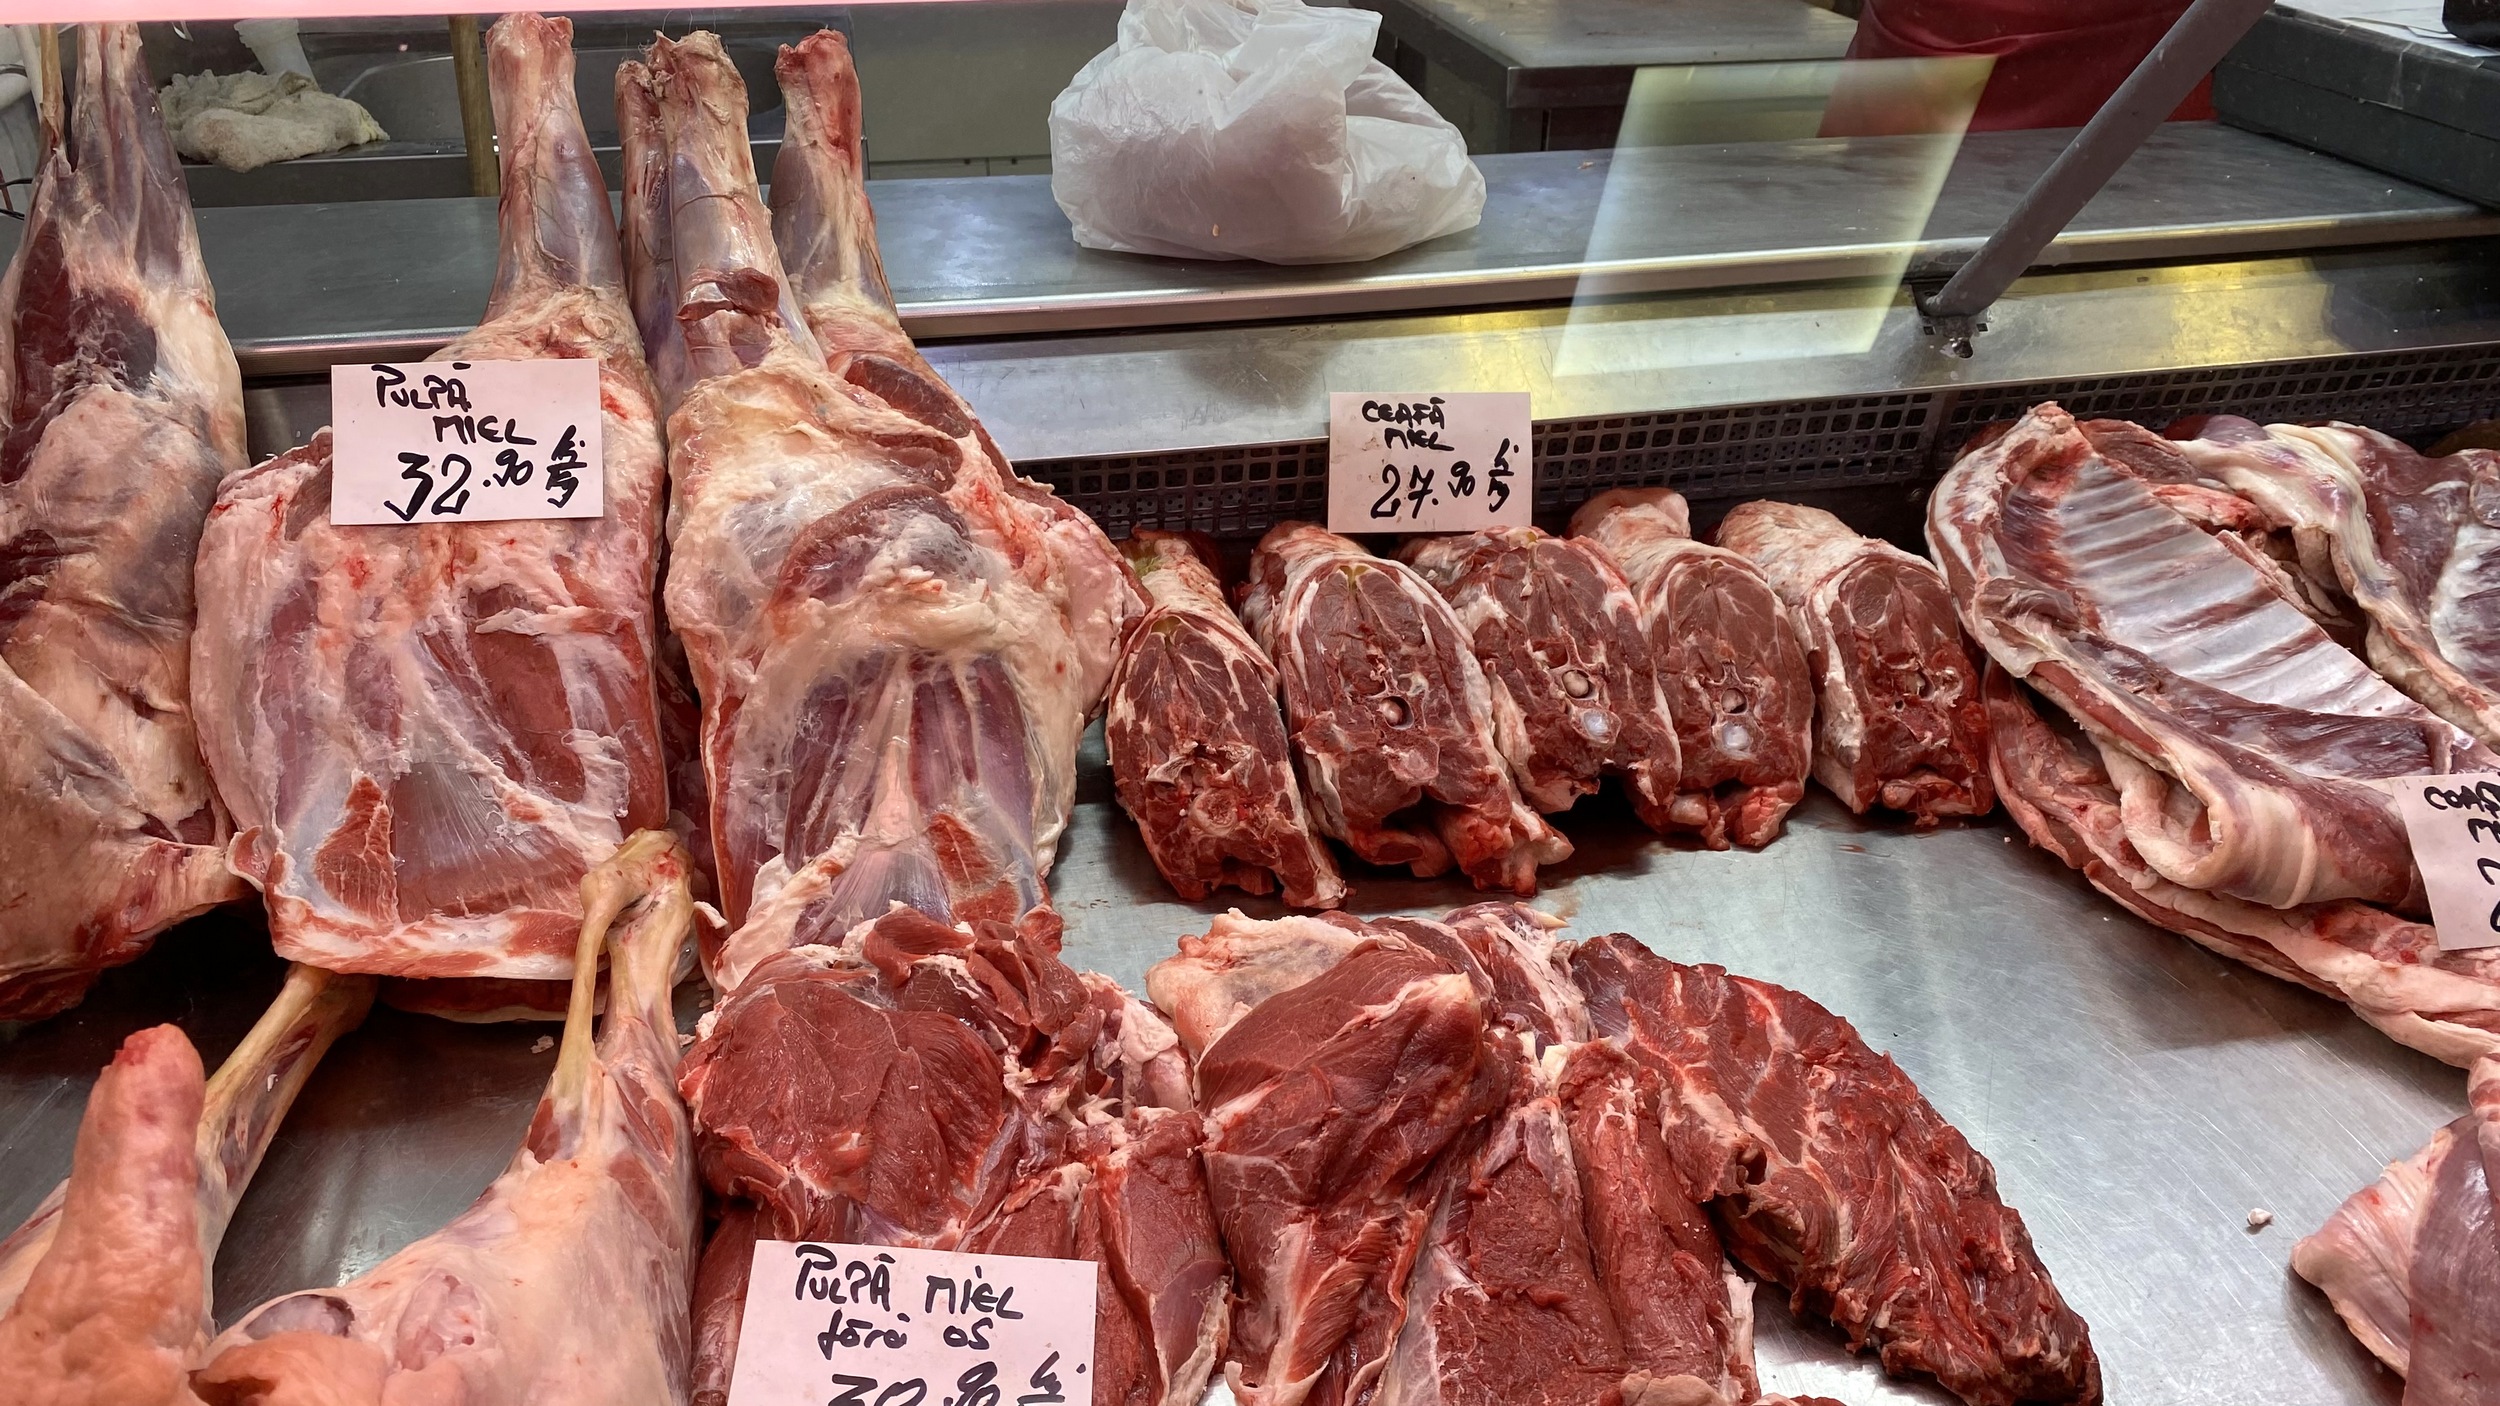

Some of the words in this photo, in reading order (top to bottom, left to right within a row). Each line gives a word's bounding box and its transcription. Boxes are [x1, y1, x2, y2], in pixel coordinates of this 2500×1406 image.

[432, 415, 537, 445] MIEL
[1384, 427, 1455, 451] MIEL
[925, 1265, 1024, 1320] MIEL
